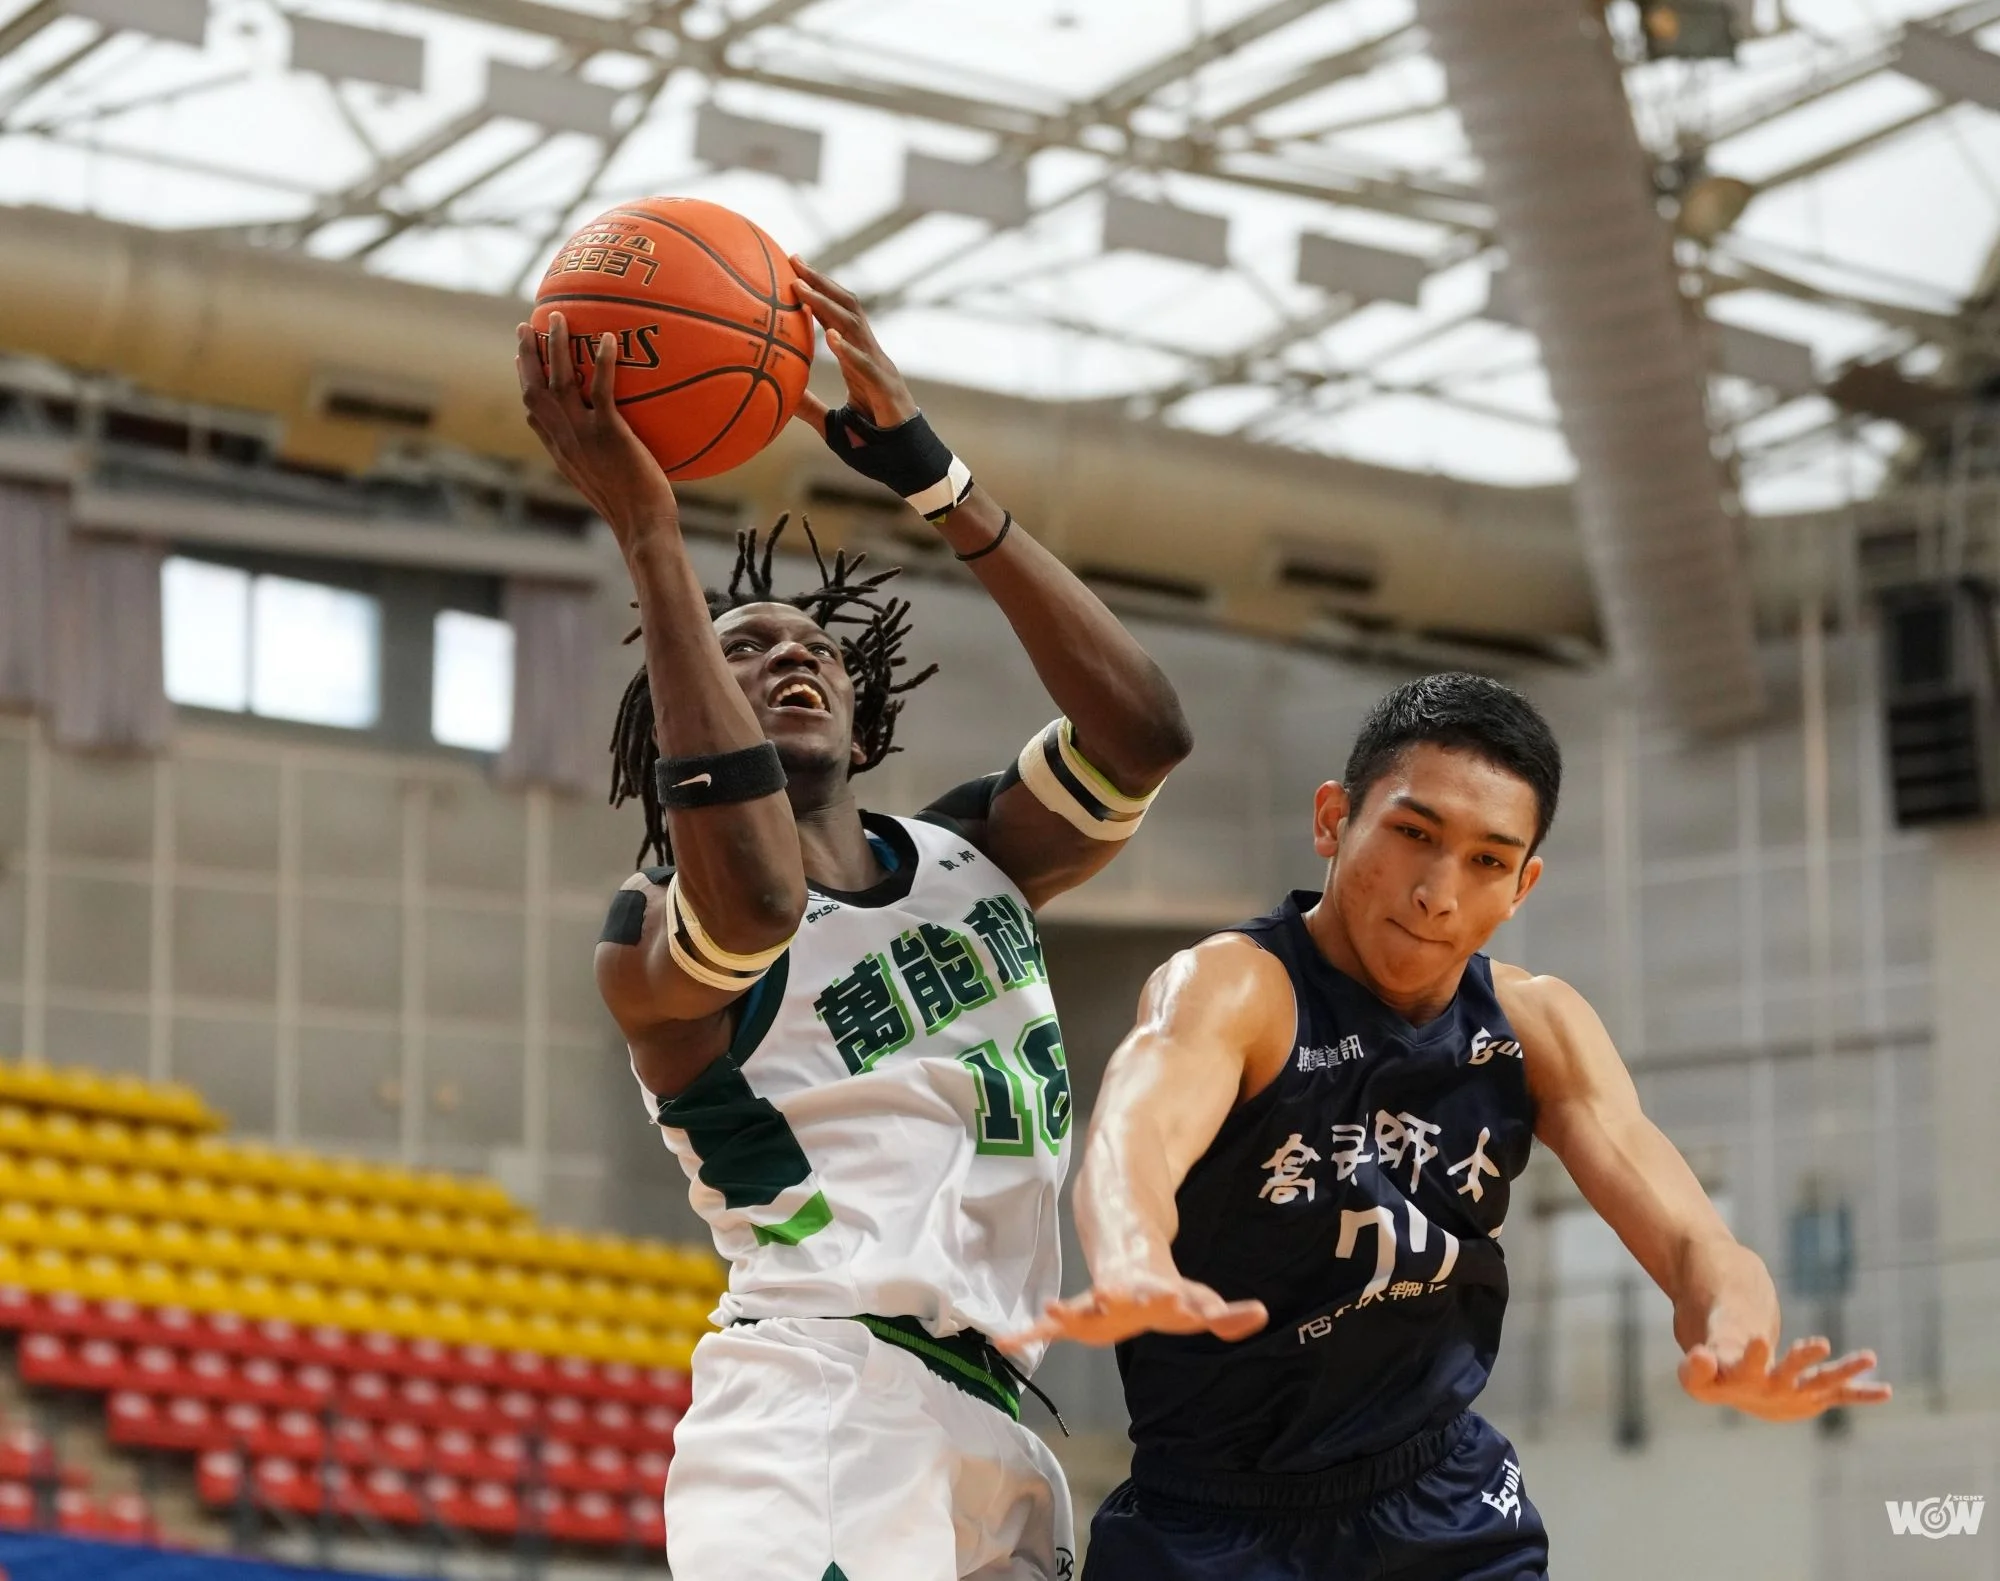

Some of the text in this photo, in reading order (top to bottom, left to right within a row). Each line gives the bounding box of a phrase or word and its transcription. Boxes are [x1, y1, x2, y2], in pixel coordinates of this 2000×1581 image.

[547, 248, 661, 287] LEGAC
[813, 893, 1048, 1078] 萬能科
[957, 1013, 1073, 1158] 18
